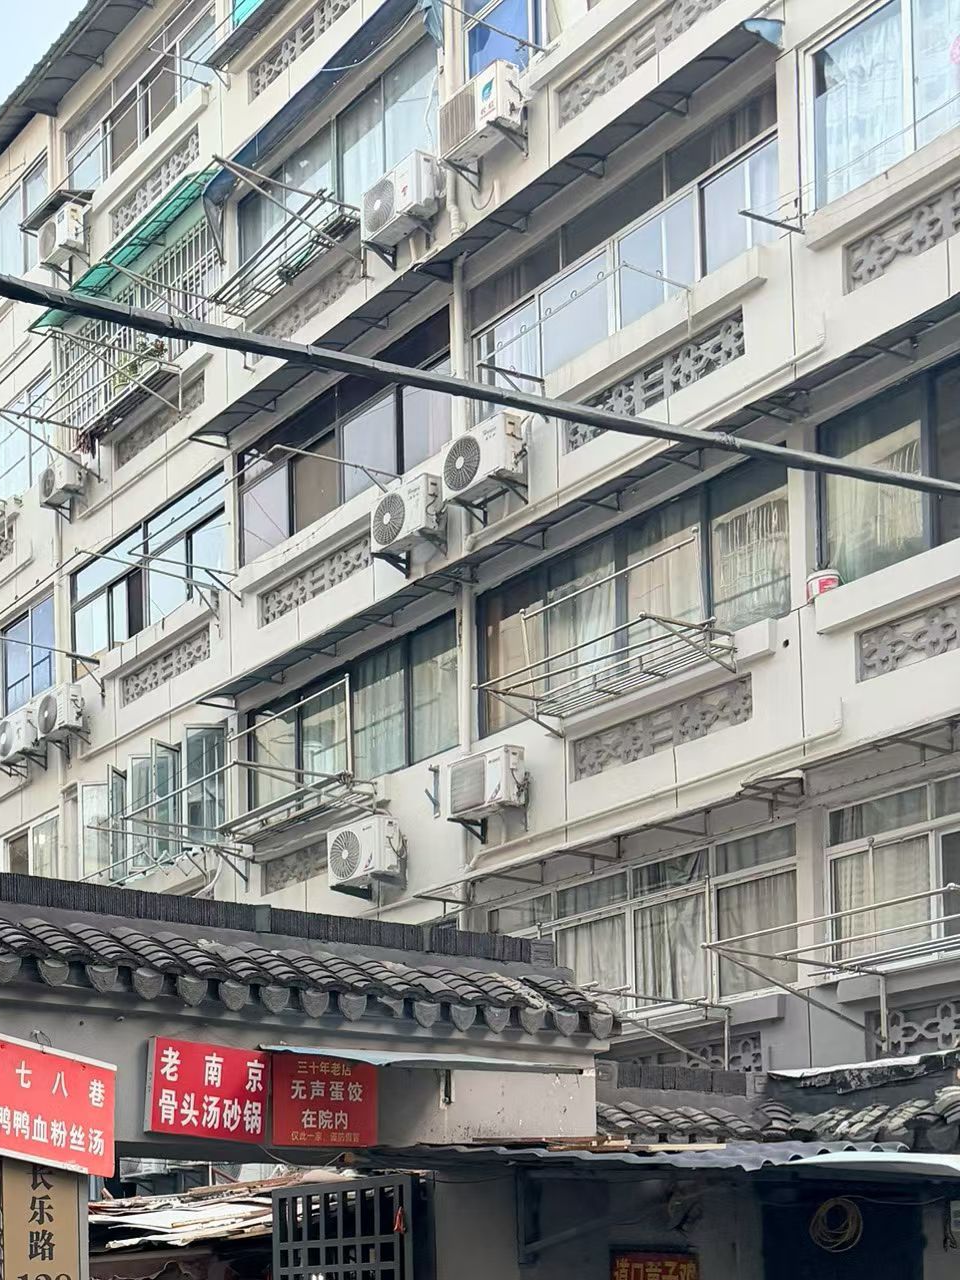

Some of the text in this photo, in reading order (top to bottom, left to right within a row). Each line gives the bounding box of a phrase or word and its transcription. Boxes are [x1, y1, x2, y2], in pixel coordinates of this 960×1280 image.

[160, 1046, 265, 1093] 老南京
[291, 1080, 363, 1102] 无声蛋饺
[158, 1088, 262, 1135] 骨头汤砂锅
[301, 1108, 348, 1130] 在院内
